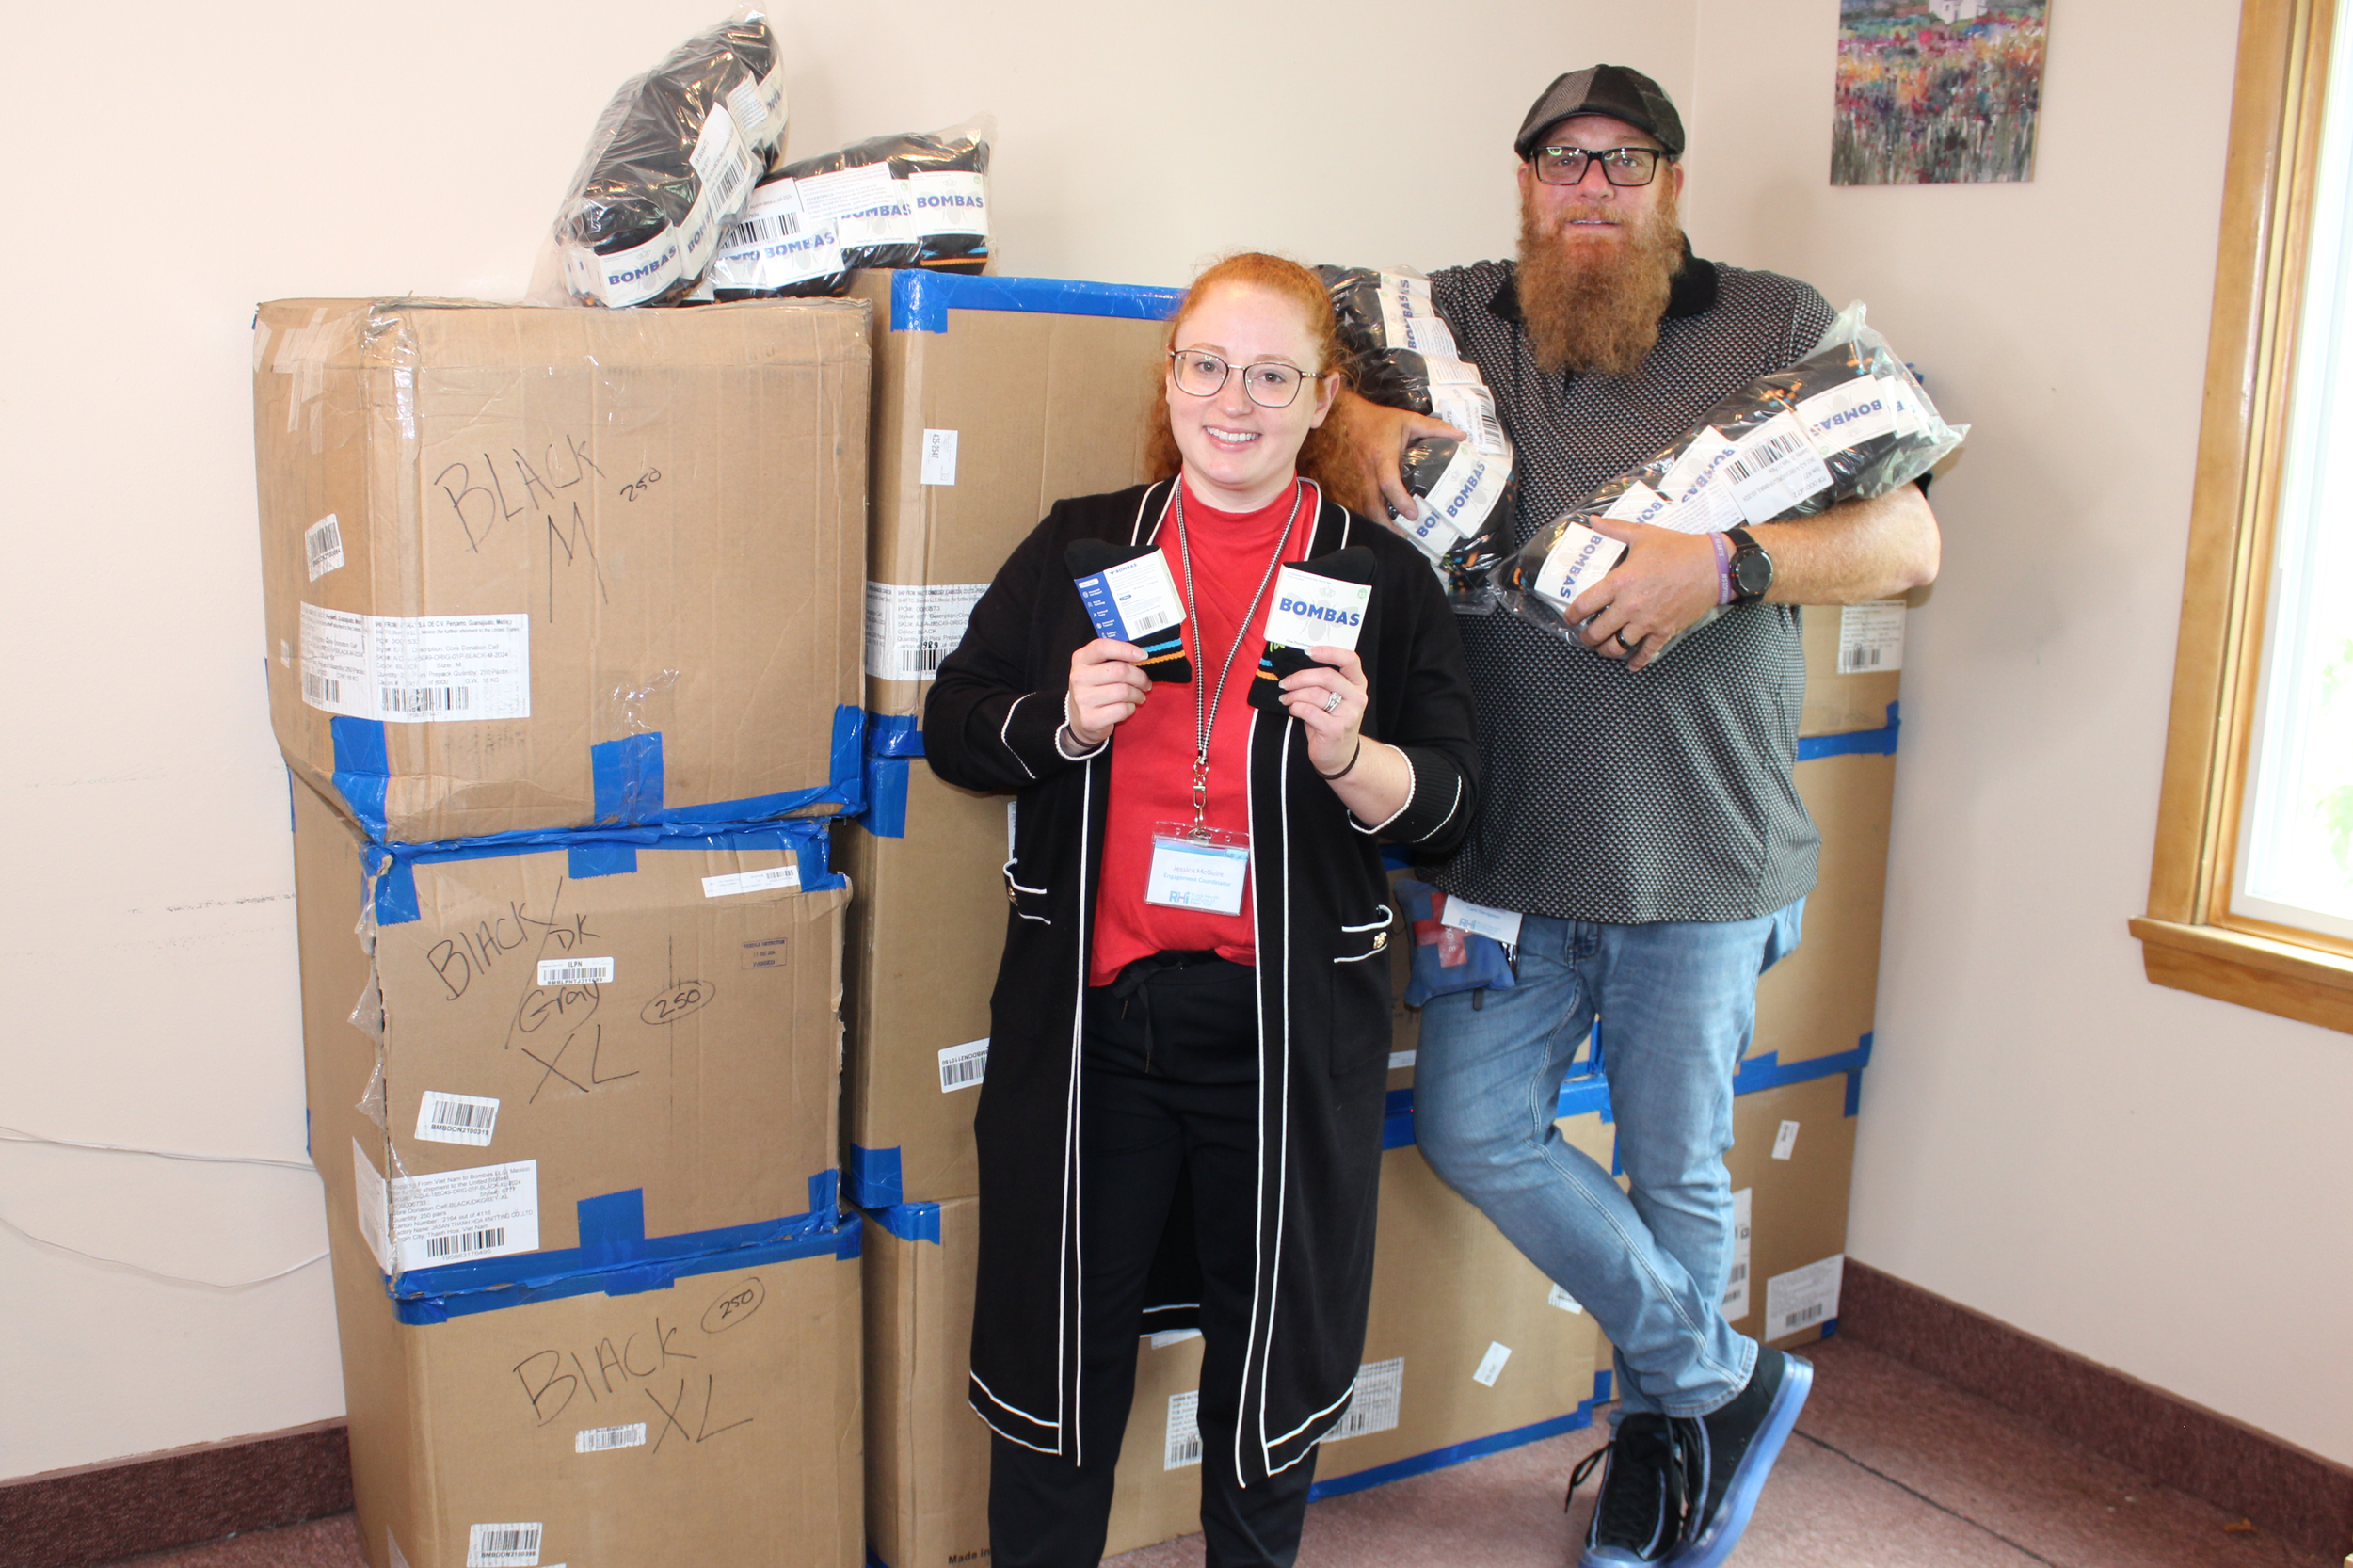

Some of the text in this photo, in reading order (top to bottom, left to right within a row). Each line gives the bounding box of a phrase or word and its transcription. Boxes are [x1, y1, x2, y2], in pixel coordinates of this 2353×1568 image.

[916, 195, 984, 209] BOMBAS
[764, 232, 835, 259] BOMBAS
[608, 245, 676, 285] BOMBAS
[1810, 399, 1882, 436] BOMBAS
[434, 434, 606, 552] BLACK
[620, 468, 661, 502] 250
[1447, 461, 1486, 518] BOMBAS
[548, 502, 608, 623] M
[1560, 535, 1603, 599] BOMBAS
[1279, 597, 1361, 627] BOMBAS
[1163, 872, 1231, 887] Engagement Coordinator
[1173, 865, 1224, 877] Jessica McGuire
[519, 980, 601, 1033] Gray
[655, 988, 701, 1018] 250
[521, 1024, 640, 1104] XL
[720, 1288, 755, 1319] 250
[645, 1374, 754, 1454] XL
[949, 1550, 978, 1565] Made
